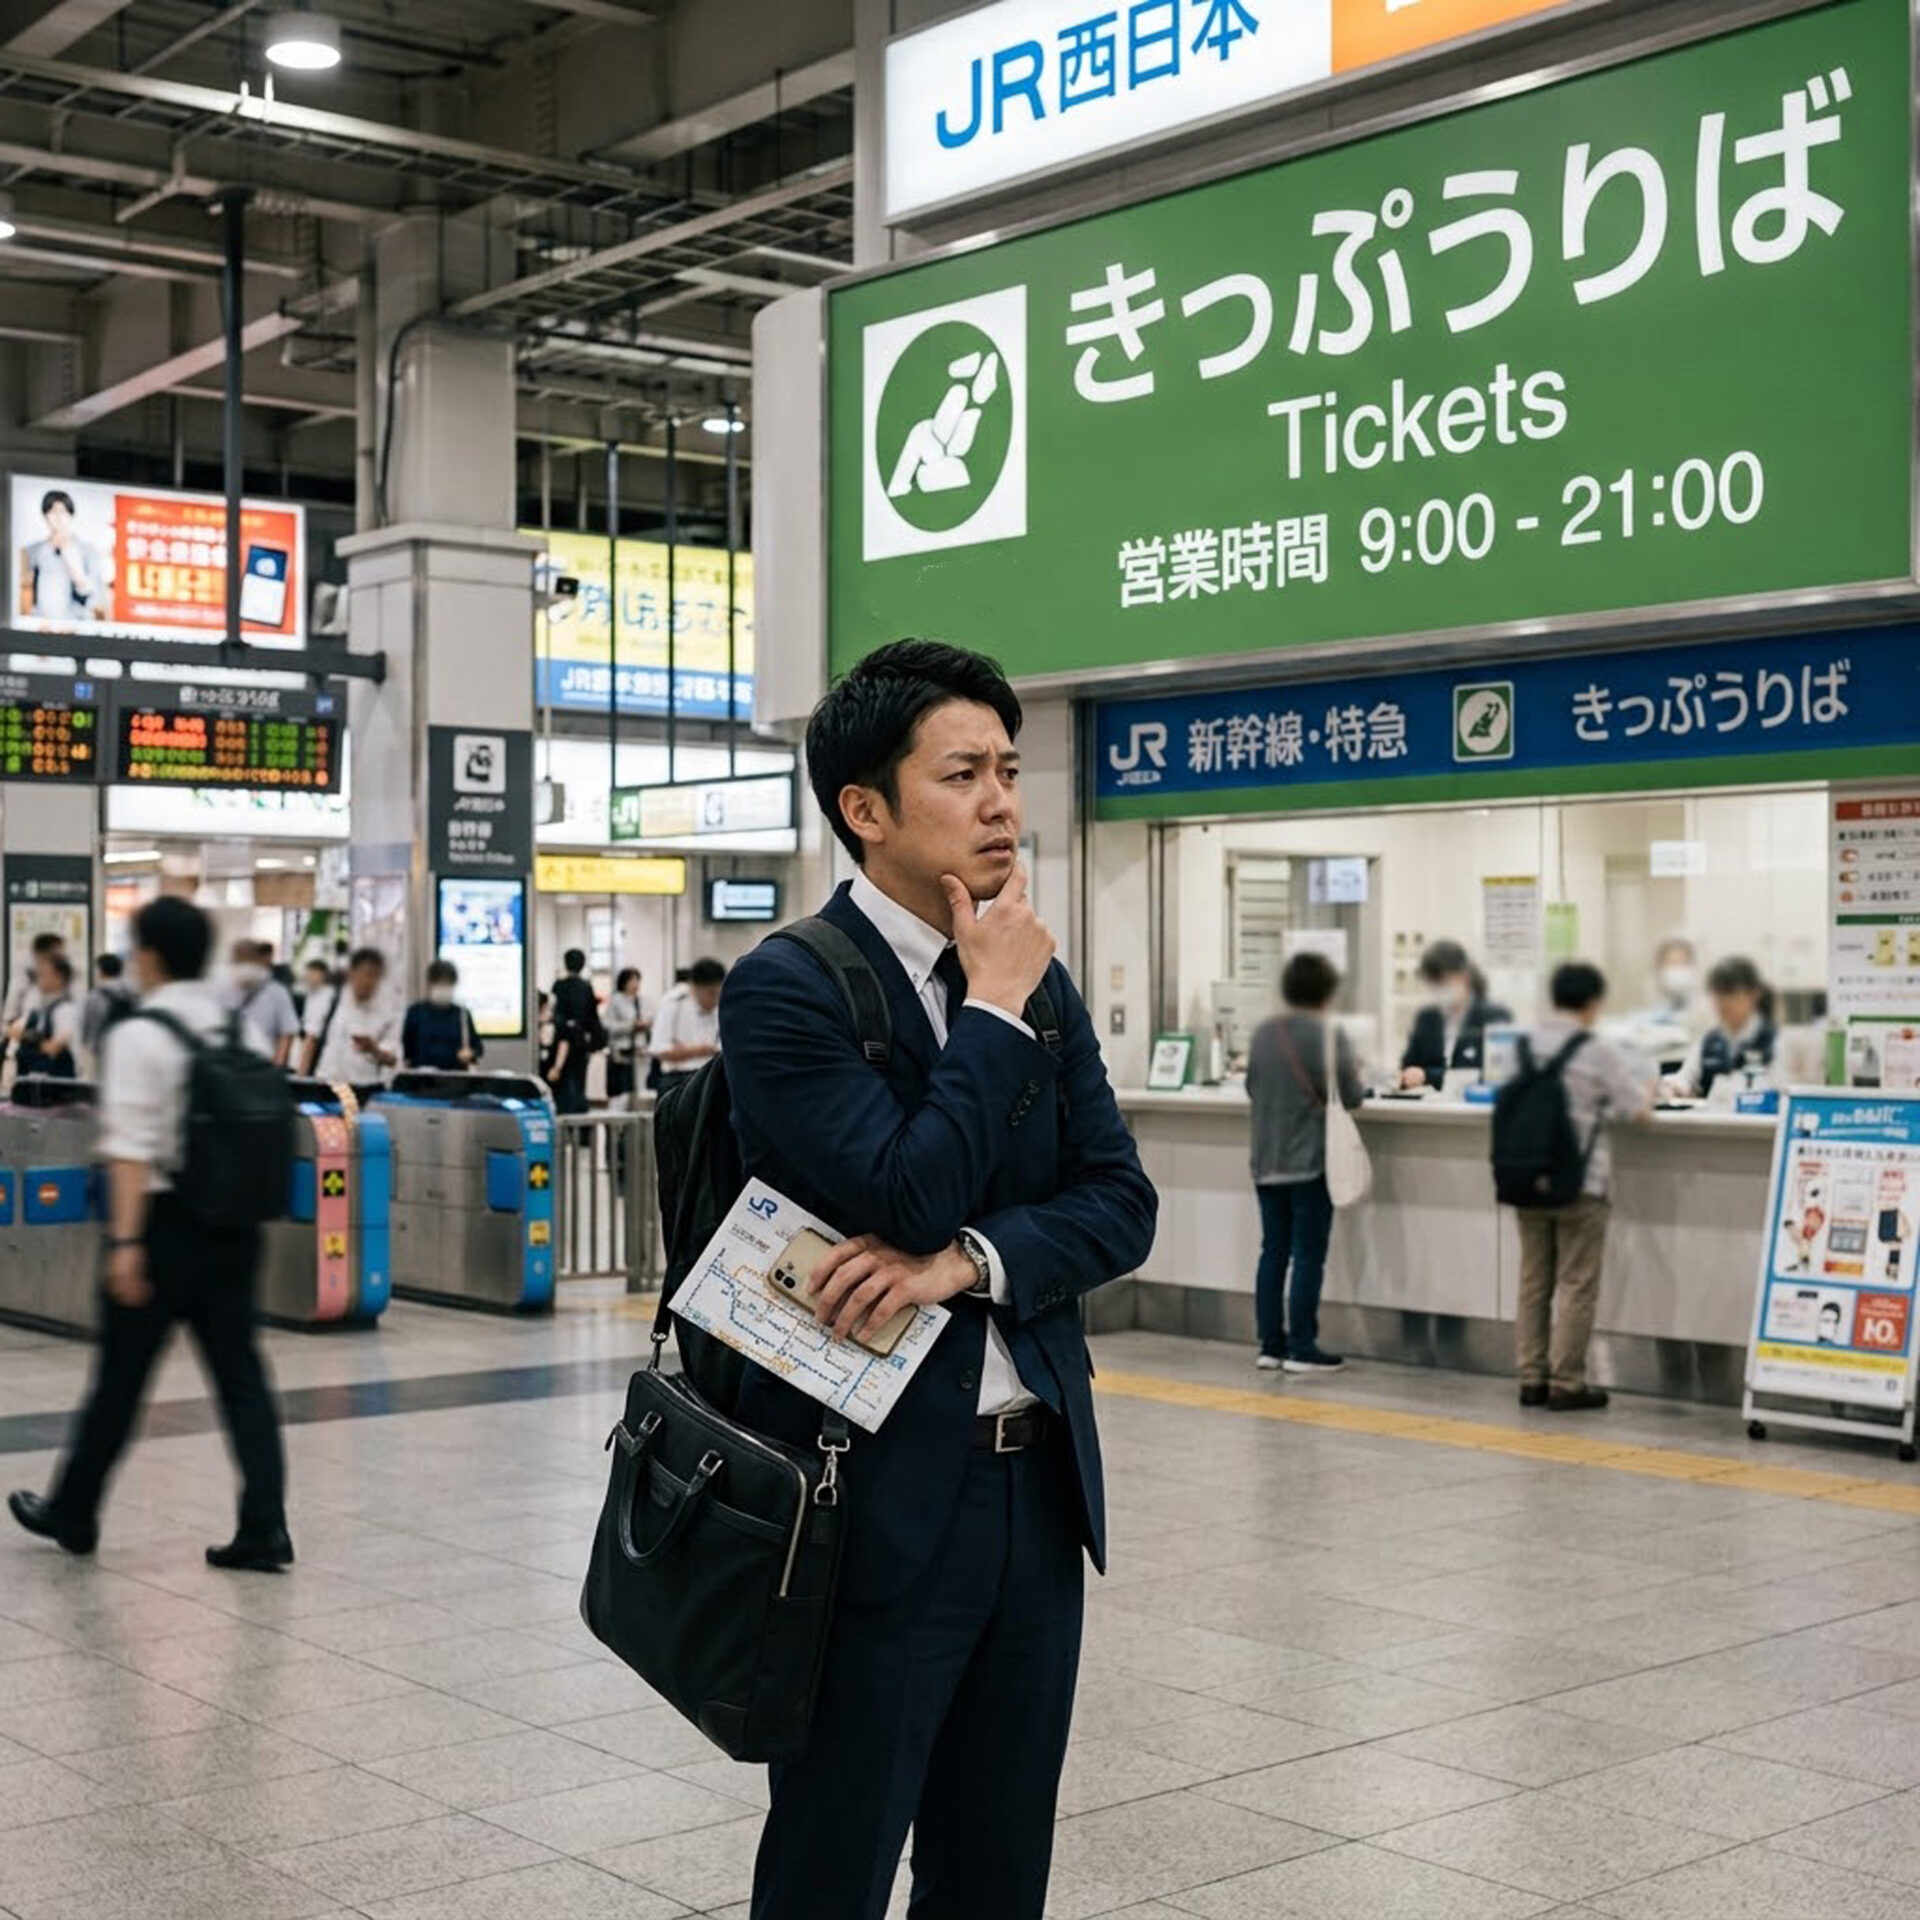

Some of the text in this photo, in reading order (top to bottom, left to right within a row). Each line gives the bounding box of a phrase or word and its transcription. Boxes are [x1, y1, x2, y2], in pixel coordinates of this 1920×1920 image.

[936, 0, 1260, 149] JR西日本
[1065, 66, 1853, 403] きっぷうりば
[1267, 363, 1568, 480] Tickets
[1118, 513, 1329, 609] 営業時間
[1359, 492, 1496, 575] 9:00
[1560, 450, 1764, 546] 21:00
[1109, 658, 1850, 773] JR 新幹線・特急 きっぷうりば
[748, 1196, 779, 1220] JR
